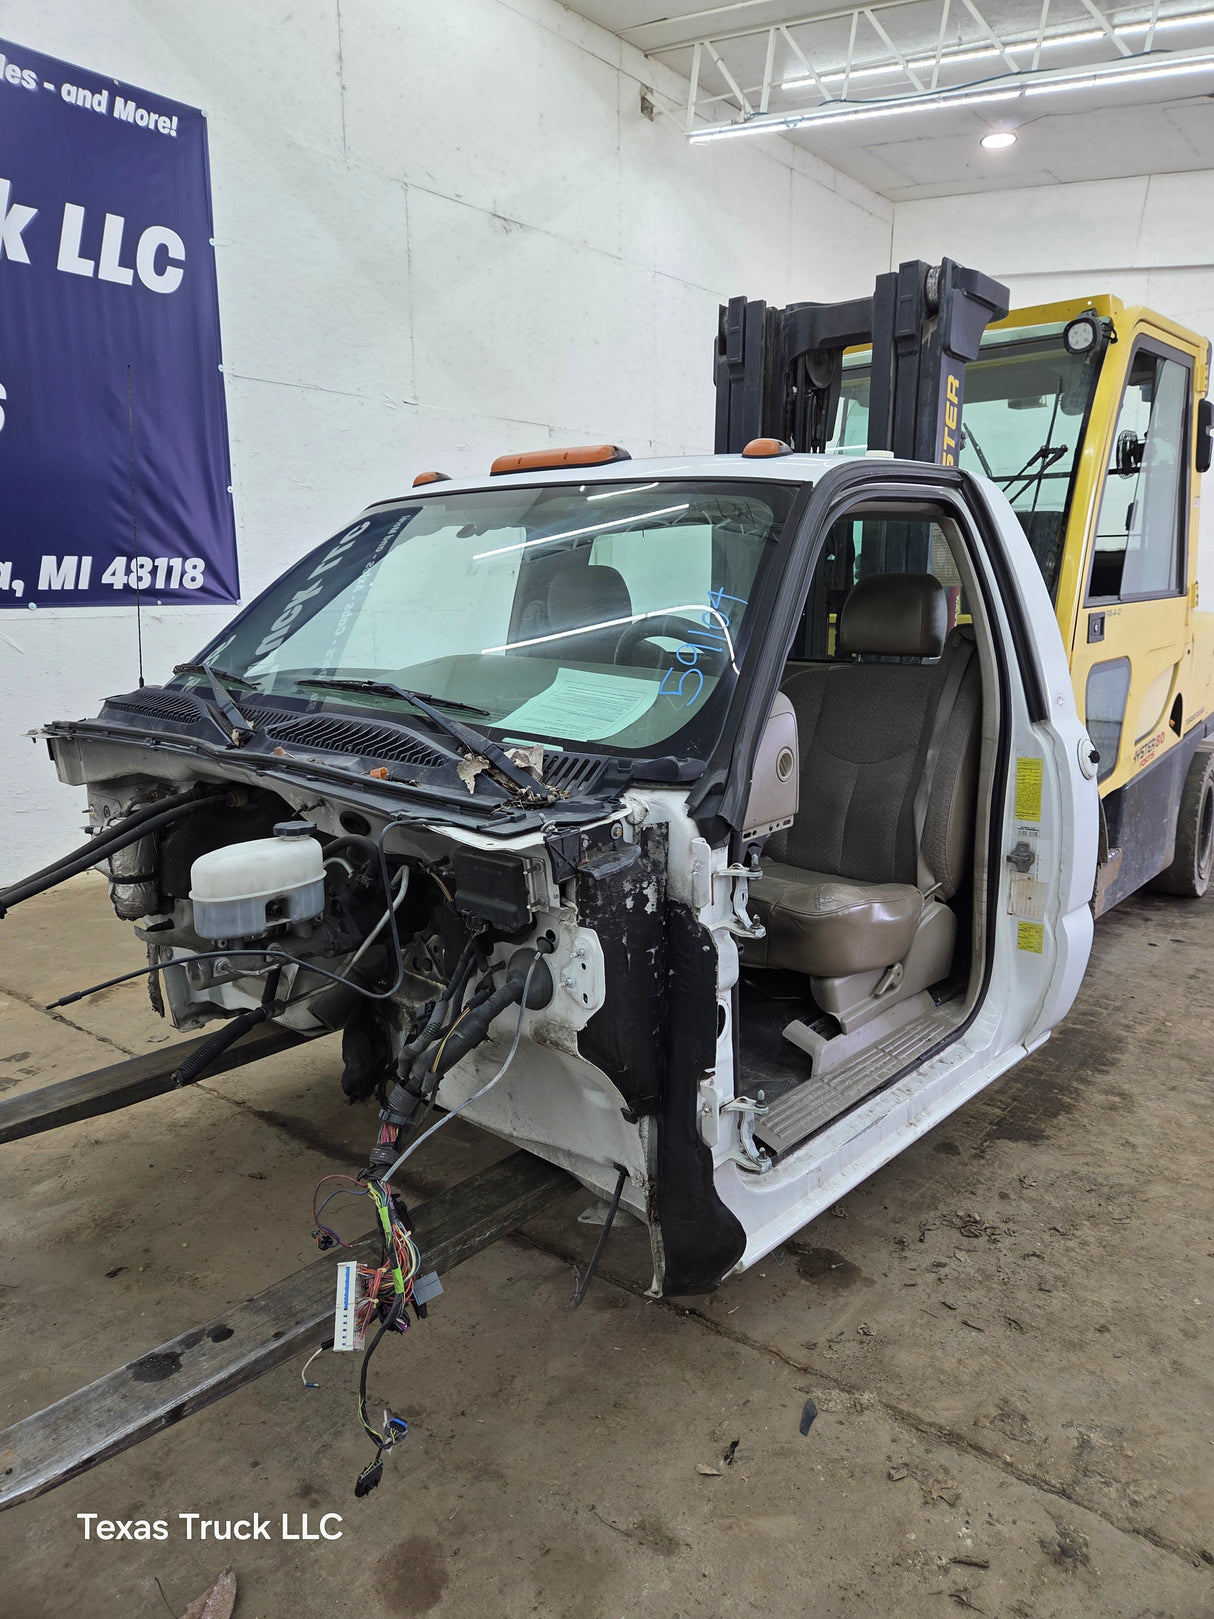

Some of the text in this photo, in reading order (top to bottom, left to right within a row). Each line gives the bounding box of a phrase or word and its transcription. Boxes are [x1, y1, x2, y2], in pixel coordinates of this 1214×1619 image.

[60, 83, 109, 115] and
[113, 96, 179, 137] More!
[57, 202, 186, 294] LLC
[38, 555, 93, 590] MI
[101, 556, 206, 590] 48118
